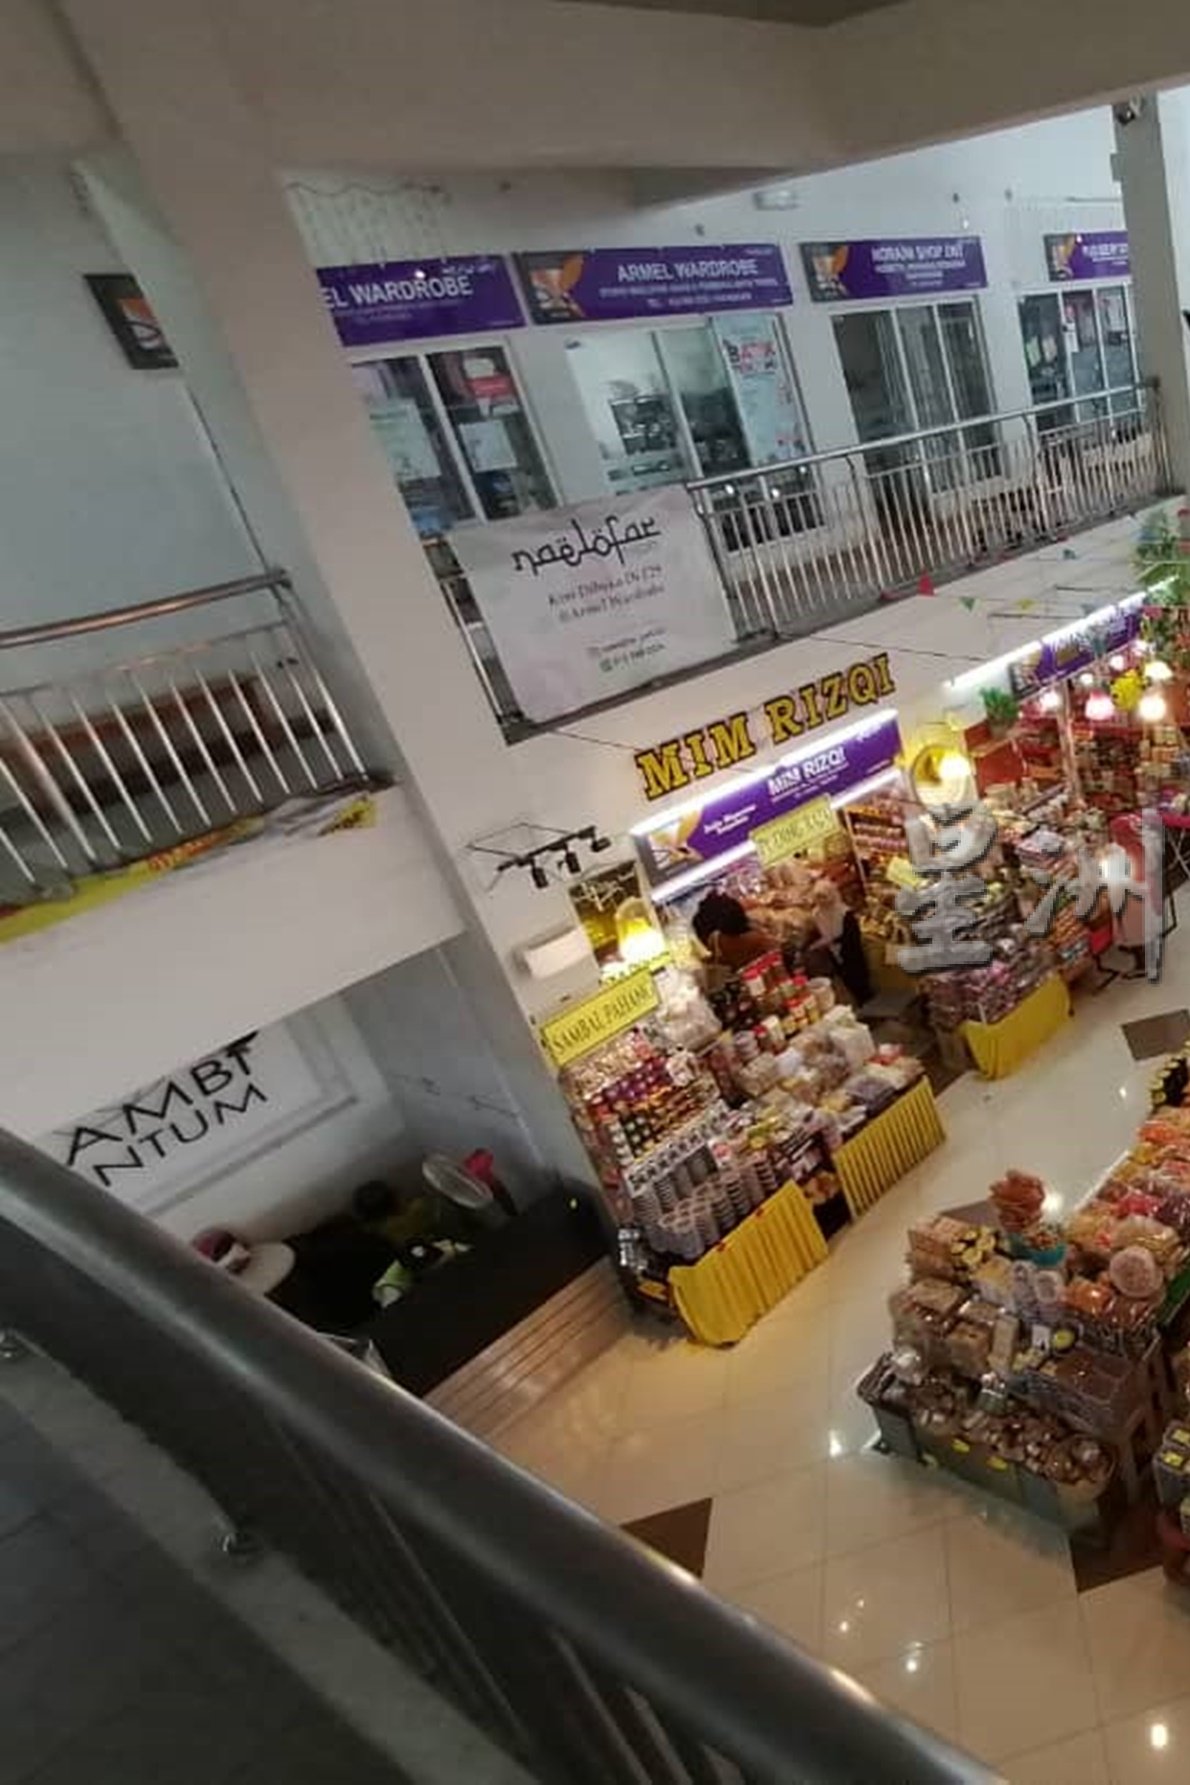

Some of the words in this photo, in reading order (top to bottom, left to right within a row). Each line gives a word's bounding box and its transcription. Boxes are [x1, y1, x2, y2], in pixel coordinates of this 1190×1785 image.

[617, 262, 674, 282] ARMEL
[675, 258, 759, 280] WARDROBE
[348, 275, 473, 305] WARDROBE
[634, 711, 757, 802] MIM
[763, 652, 896, 745] RIZQI
[803, 746, 847, 779] RIZQI
